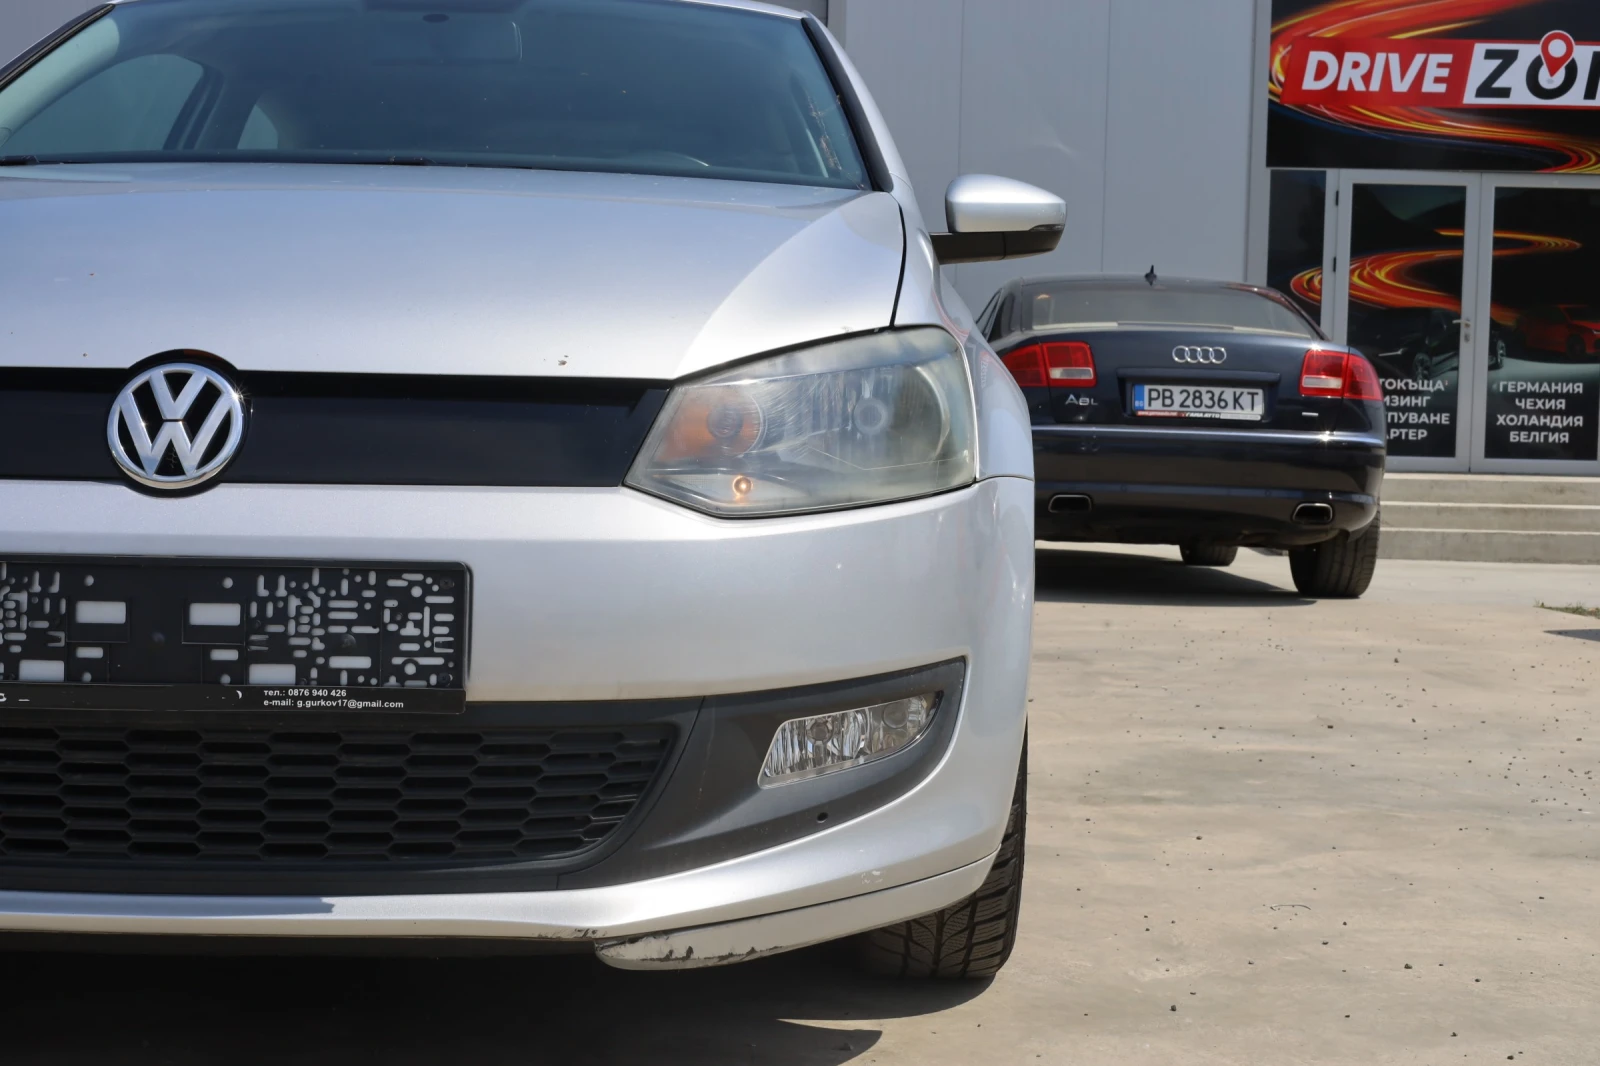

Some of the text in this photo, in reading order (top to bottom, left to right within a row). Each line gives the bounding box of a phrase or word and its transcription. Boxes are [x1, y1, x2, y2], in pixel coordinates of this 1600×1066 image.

[1301, 51, 1453, 93] DRIVE
[1500, 381, 1583, 394] ГЕРМАНИЯ
[1148, 388, 1259, 411] PB 2836 KT
[1515, 398, 1566, 410] ЧЕХИЯ
[1386, 412, 1450, 425] ПУВАНЕ
[1496, 414, 1584, 428] ХОЛАНДИЯ
[1386, 428, 1428, 440] РТЕР
[1509, 431, 1569, 444] БЕЛГИЯ
[287, 688, 310, 697] 0876
[312, 689, 328, 697] 940
[330, 689, 347, 698] 426
[263, 698, 404, 709] e-mail: g.gurkov17@gmail.com
